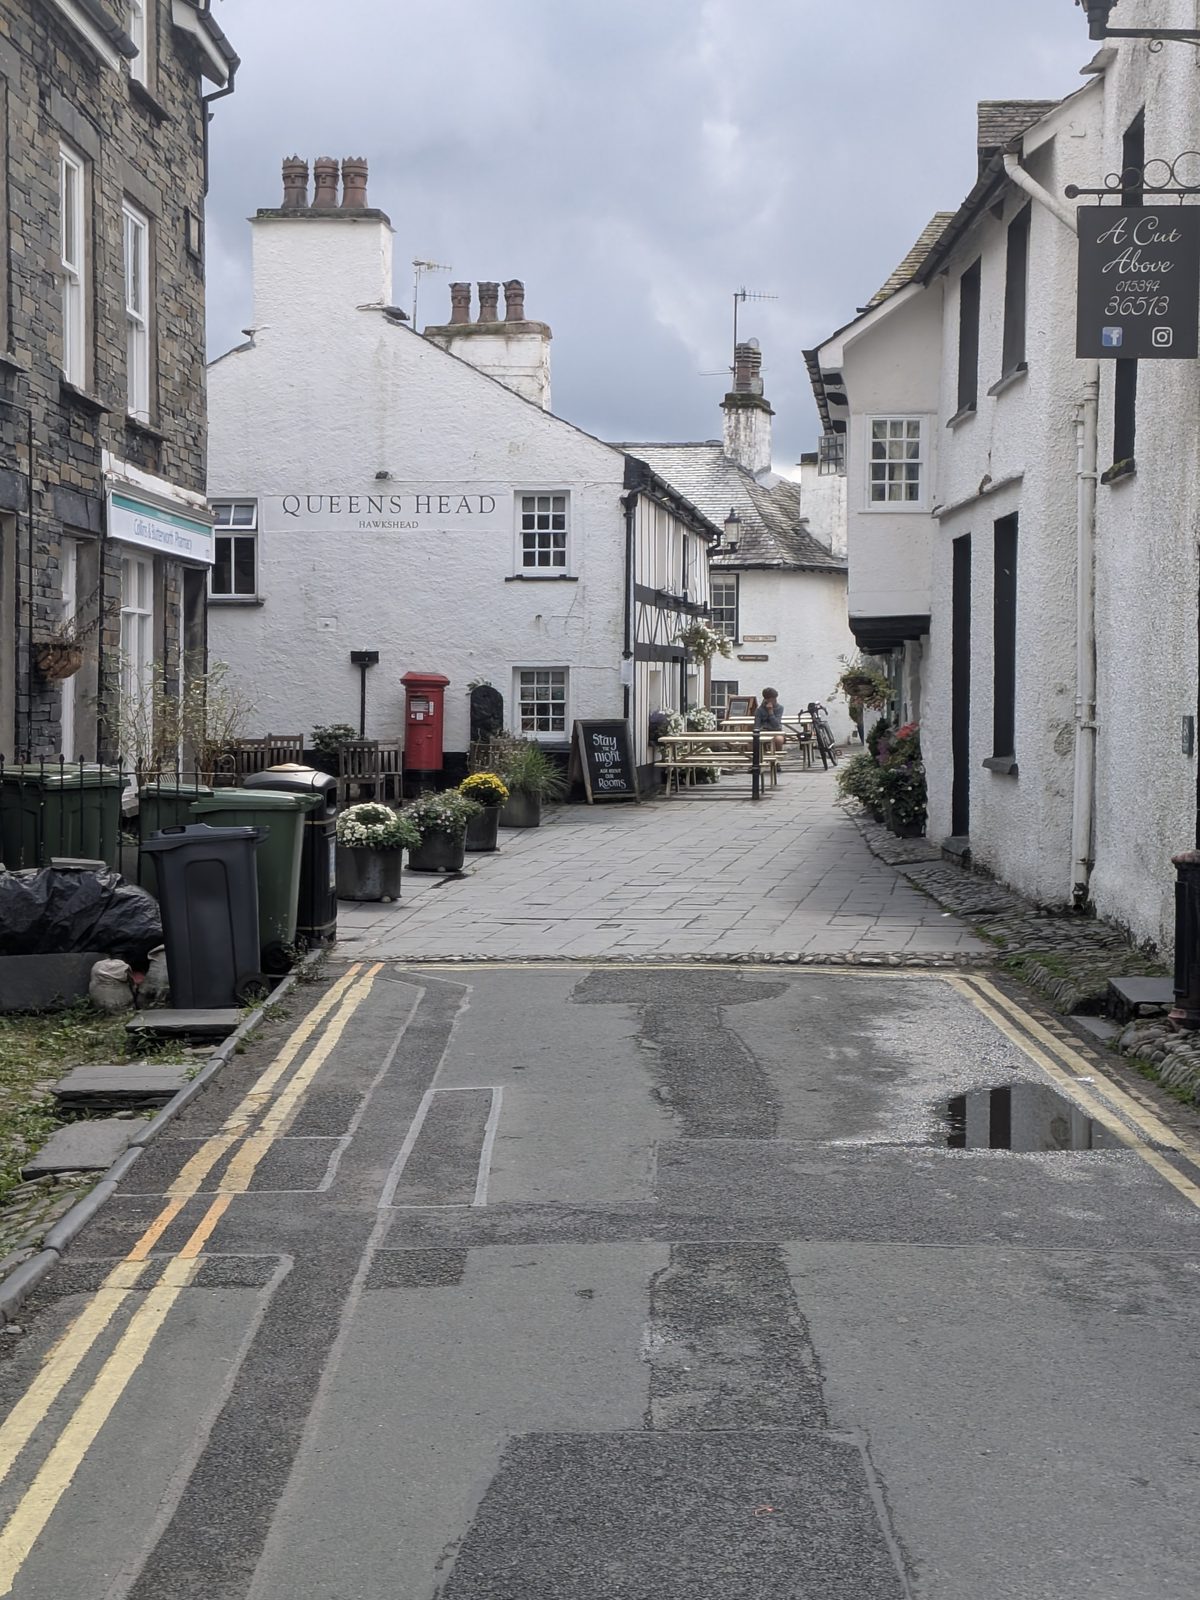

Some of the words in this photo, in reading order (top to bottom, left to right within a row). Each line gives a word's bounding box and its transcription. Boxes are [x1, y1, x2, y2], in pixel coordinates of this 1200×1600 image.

[1097, 216, 1128, 245] A
[1133, 215, 1182, 246] Cut
[1102, 246, 1175, 274] Above
[1115, 279, 1161, 293] 015394
[1104, 295, 1170, 316] 36513
[282, 494, 402, 518] QUEENS
[415, 494, 496, 515] HEAD
[358, 520, 419, 529] HAWKSHEAD
[592, 733, 617, 751] Stay
[594, 750, 621, 767] night
[598, 778, 627, 790] Rooms
